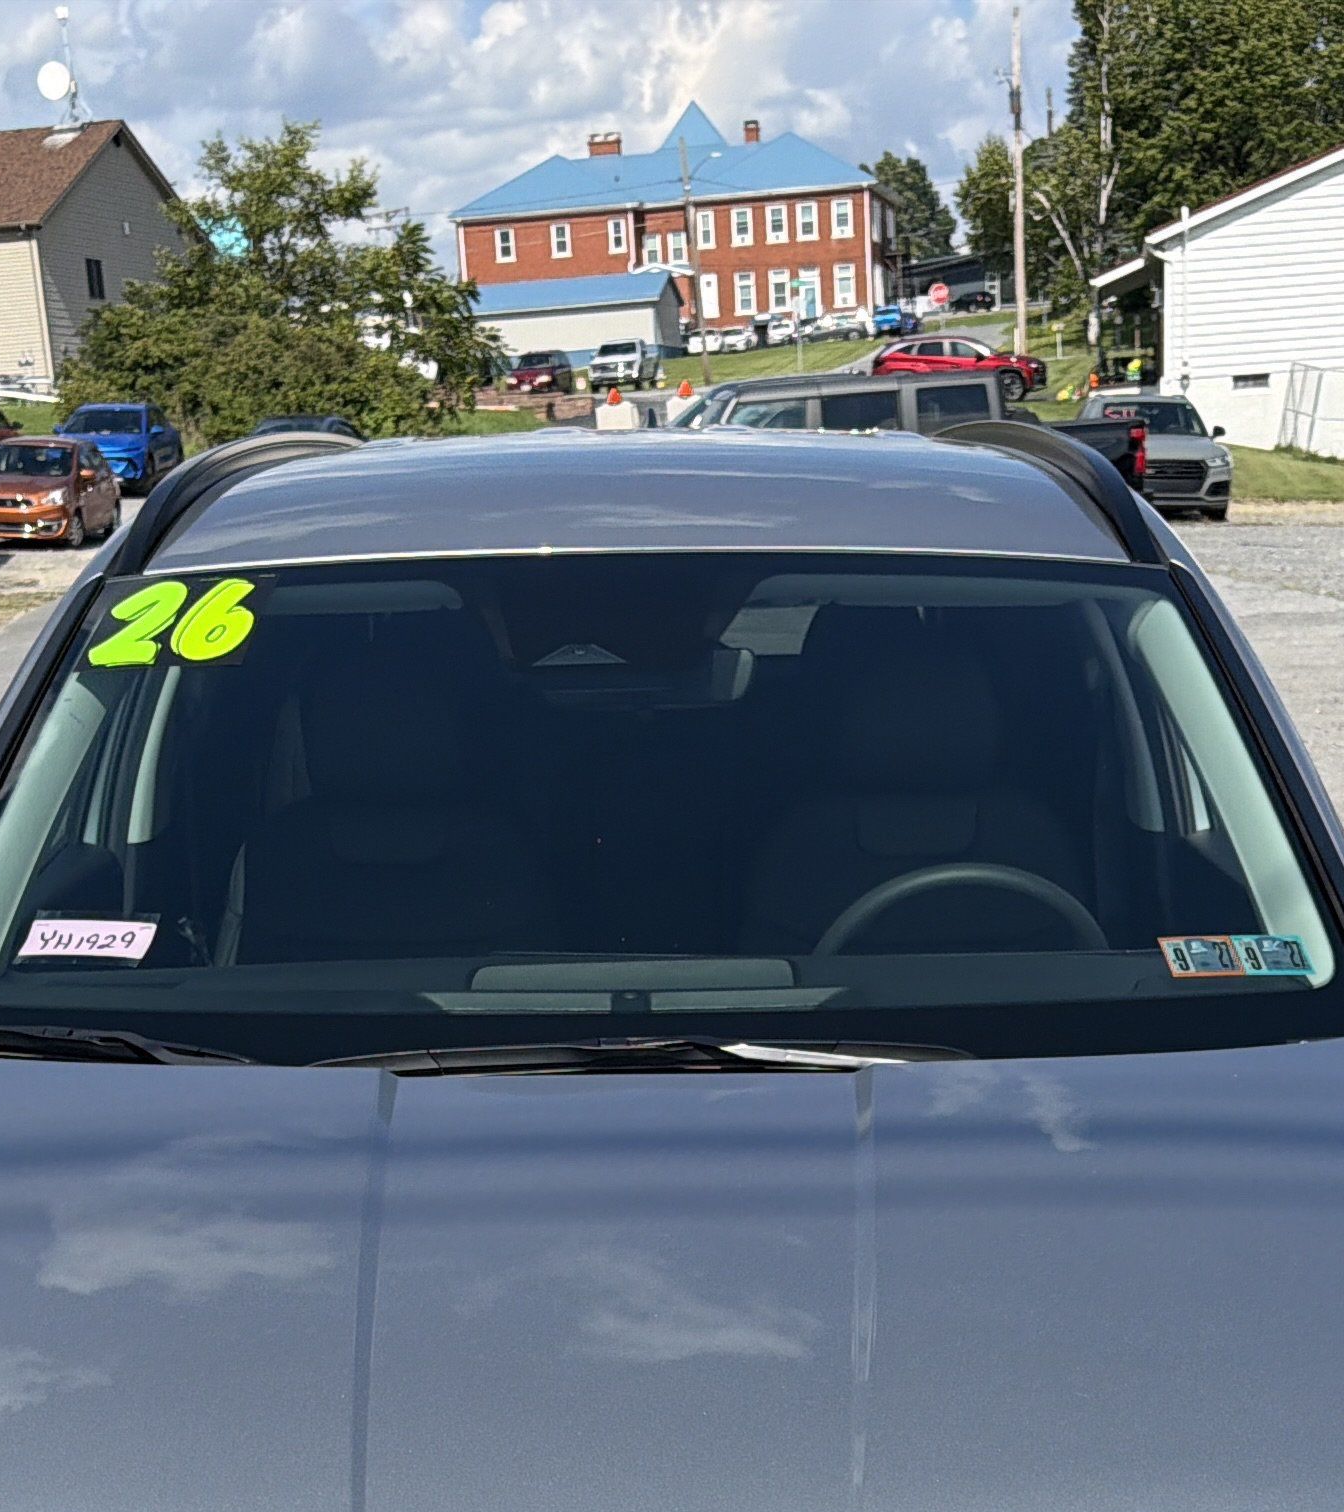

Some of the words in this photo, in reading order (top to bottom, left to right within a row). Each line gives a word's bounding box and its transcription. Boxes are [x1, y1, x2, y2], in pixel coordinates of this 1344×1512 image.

[88, 578, 256, 667] 26
[39, 929, 137, 951] YH1929
[1173, 947, 1191, 972] 9
[1245, 946, 1263, 971] 9
